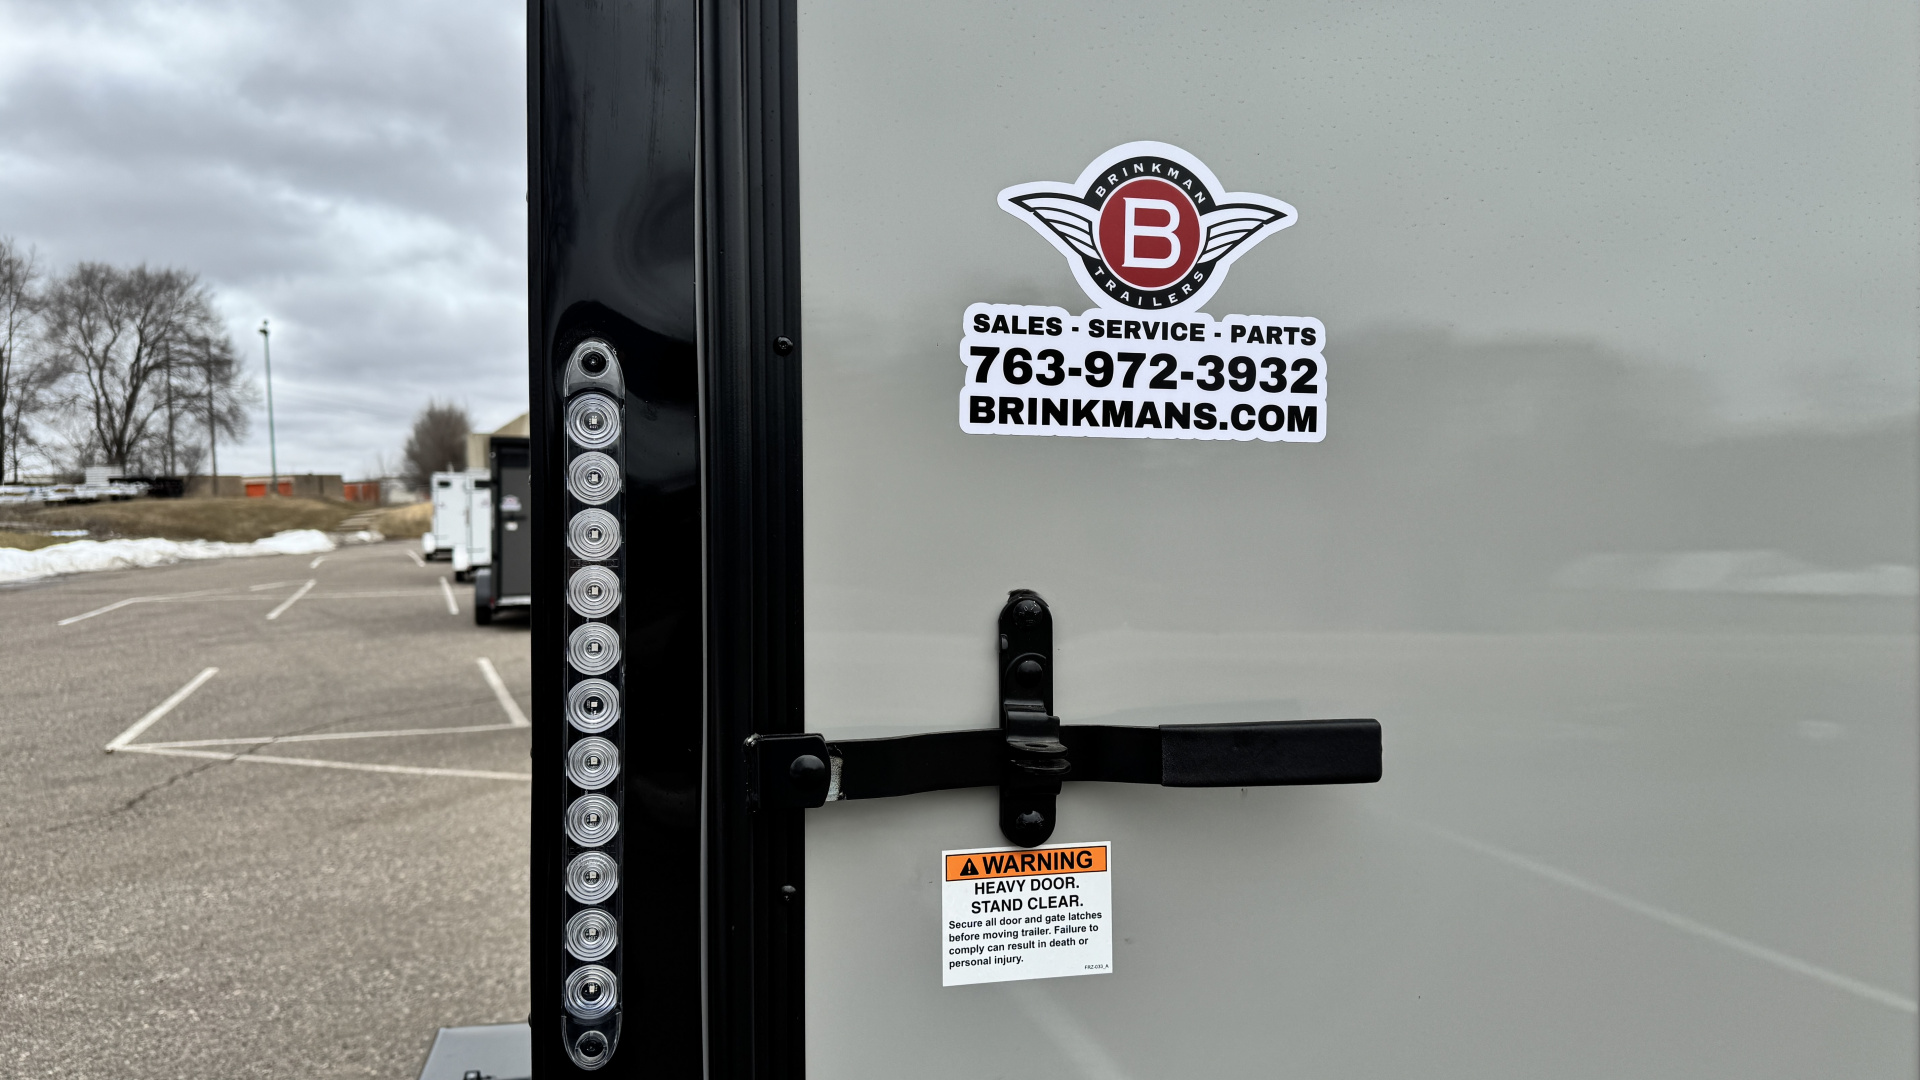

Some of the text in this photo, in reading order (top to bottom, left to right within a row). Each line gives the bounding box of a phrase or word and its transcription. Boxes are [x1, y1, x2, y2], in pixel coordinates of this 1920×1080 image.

[1095, 163, 1206, 204] BRINKMAN
[1122, 197, 1181, 268] B
[1094, 266, 1204, 307] TRAILERS
[973, 313, 1062, 336] SALES
[1088, 319, 1205, 342] SERVICE
[1231, 325, 1316, 345] PARTS
[969, 346, 1318, 394] 763-972-3932
[969, 396, 1317, 432] BRINKMANS.COM
[982, 851, 1092, 874] WARNING
[975, 877, 1079, 895] HEAVY DOOR.
[971, 895, 1083, 914] STAND CLEAR.
[949, 911, 1102, 929] Secure all door and gate latches
[949, 932, 980, 942] before
[983, 929, 1018, 940] moving
[1021, 927, 1051, 936] trailer.
[1054, 925, 1086, 934] Failure
[949, 944, 984, 955] comply
[988, 944, 1004, 952] can
[1008, 940, 1035, 950] result
[1038, 939, 1046, 948] in
[1050, 938, 1075, 947] death
[949, 955, 1023, 969] personal injury.
